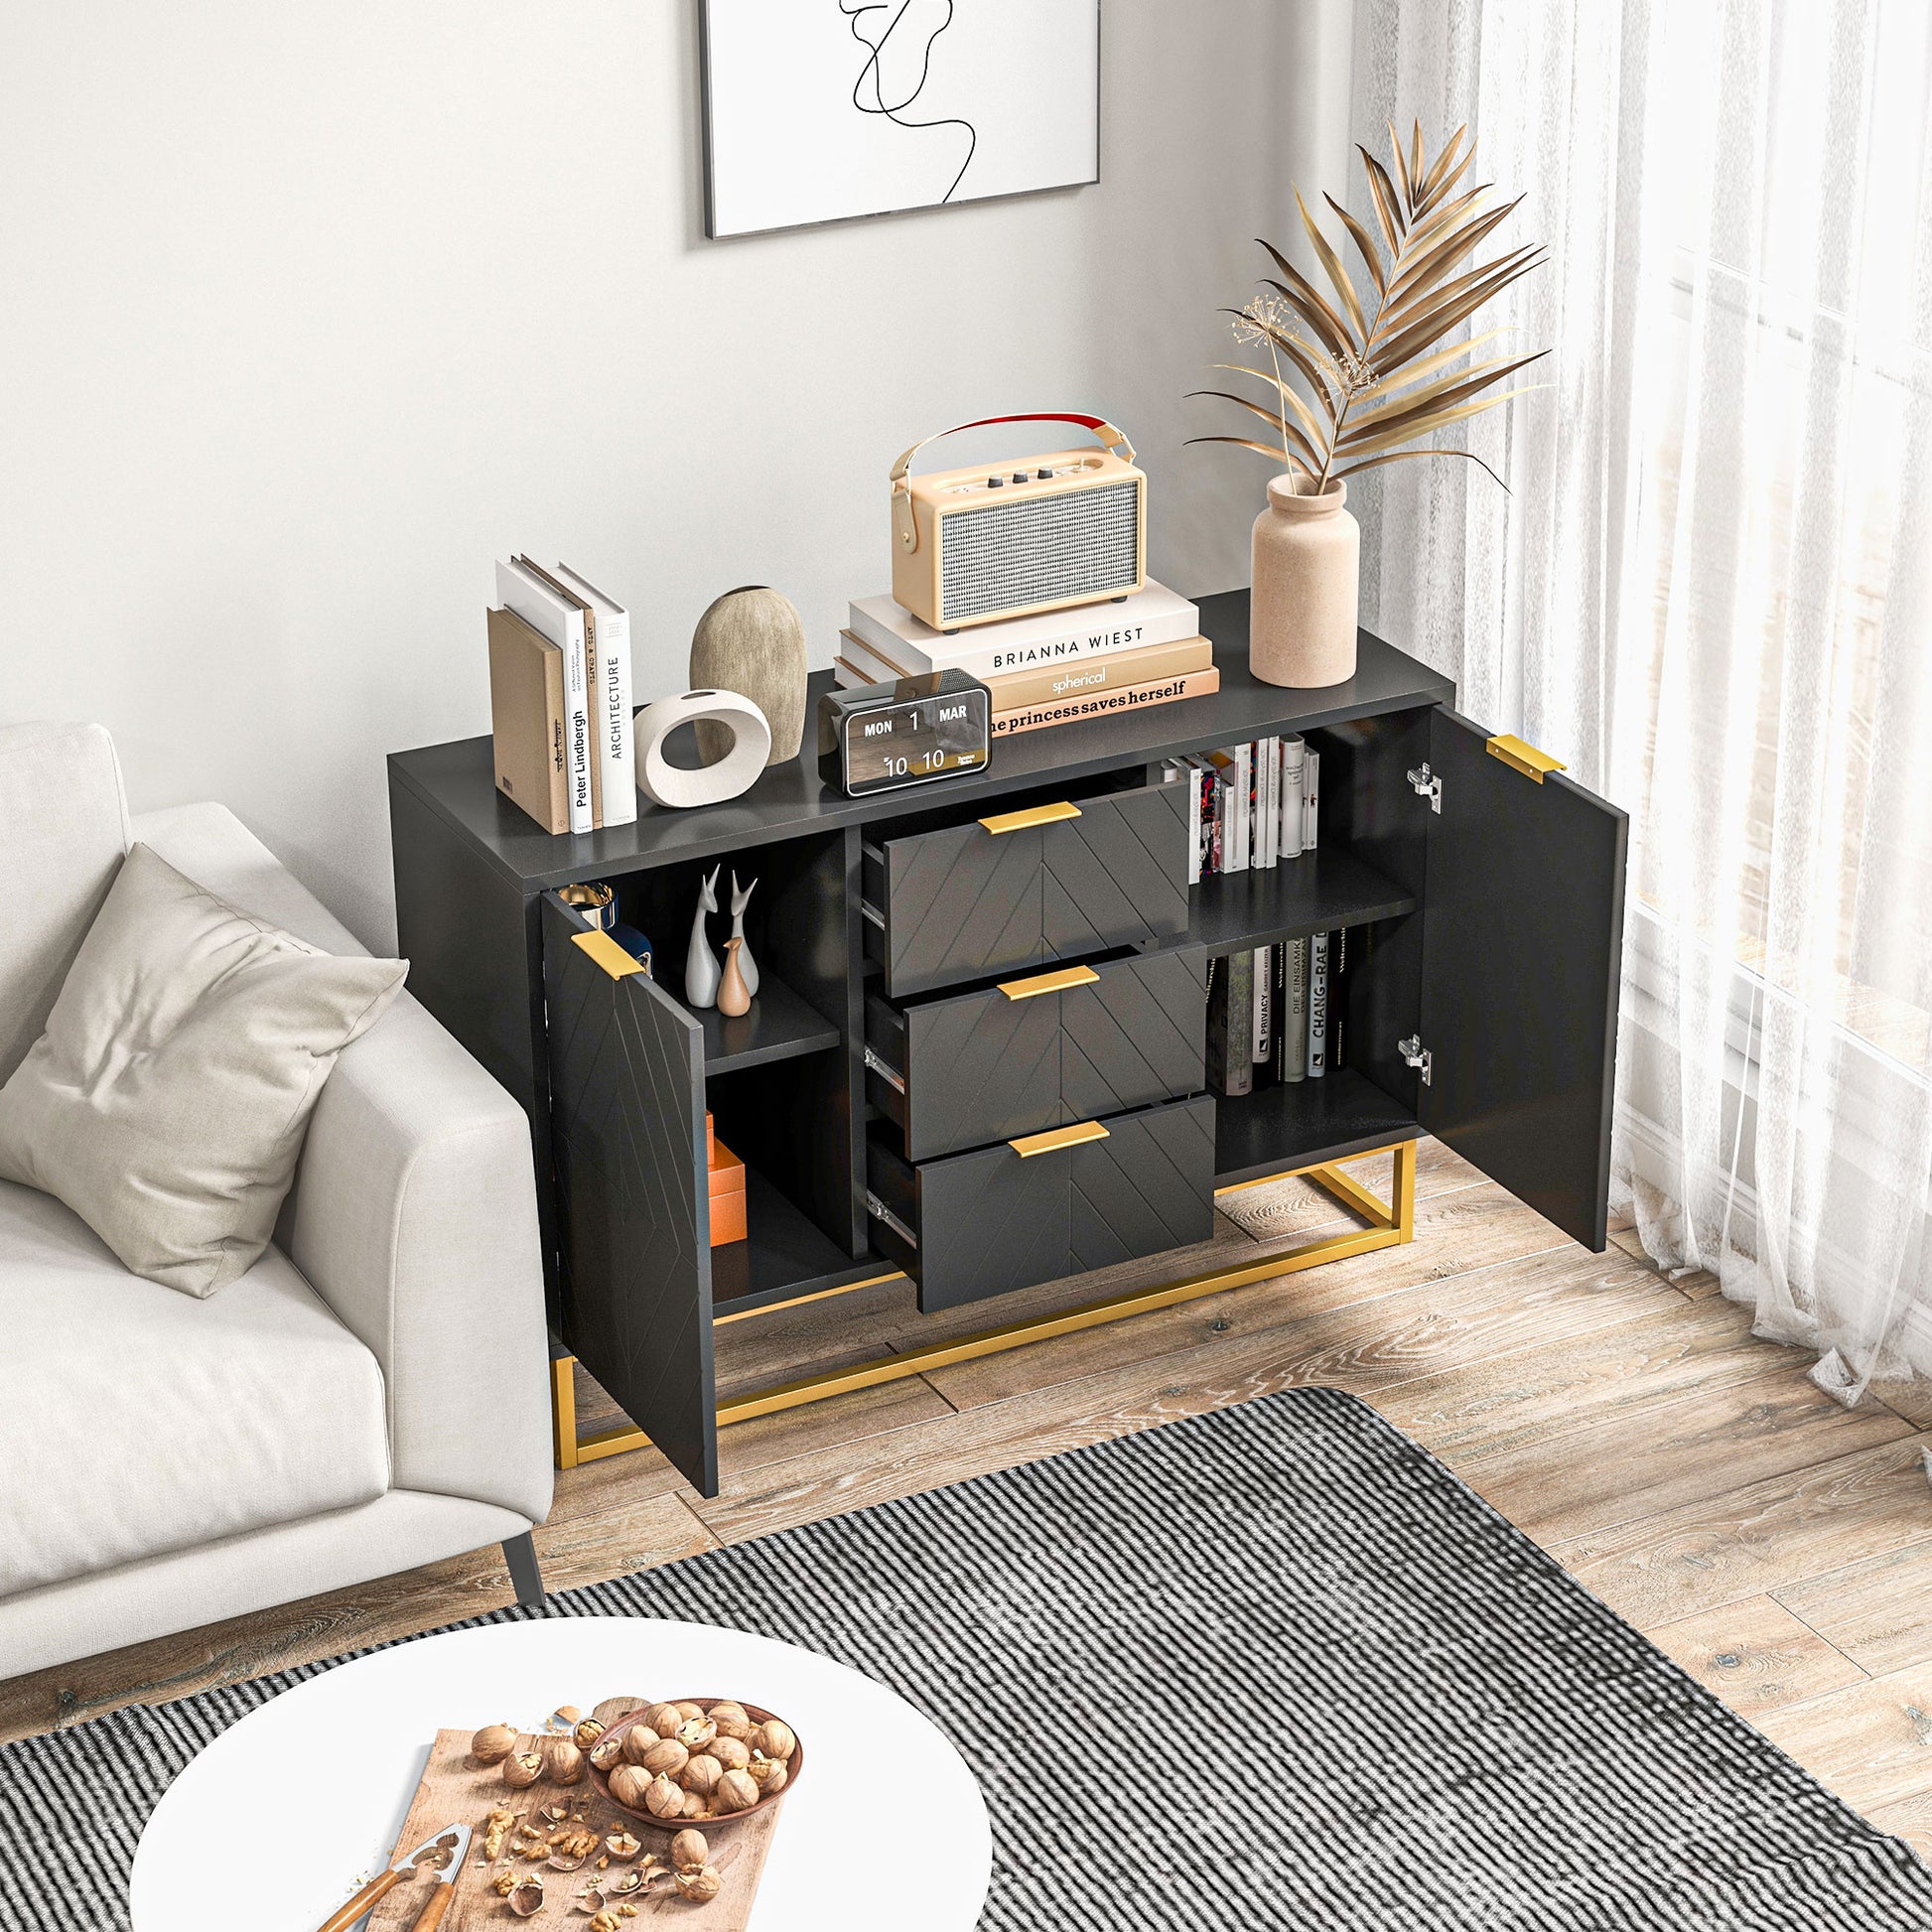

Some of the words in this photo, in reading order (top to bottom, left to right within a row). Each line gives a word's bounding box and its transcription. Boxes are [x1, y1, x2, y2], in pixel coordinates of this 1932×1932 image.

[993, 640, 1079, 668] BRIANNA
[1088, 627, 1144, 649] WIEST
[1051, 667, 1107, 695] spherical
[608, 656, 622, 759] ARCHITECTURE
[865, 720, 893, 737] MON
[909, 711, 917, 731] 1
[939, 705, 967, 722] MAR
[1009, 706, 1079, 732] princess
[1081, 694, 1126, 716] saves
[1128, 681, 1186, 704] herself
[573, 709, 586, 772] Lindbergh
[886, 757, 908, 777] 10
[922, 750, 944, 769] 10
[576, 775, 588, 808] Peter
[1312, 945, 1326, 1038] CHANG-RAE
